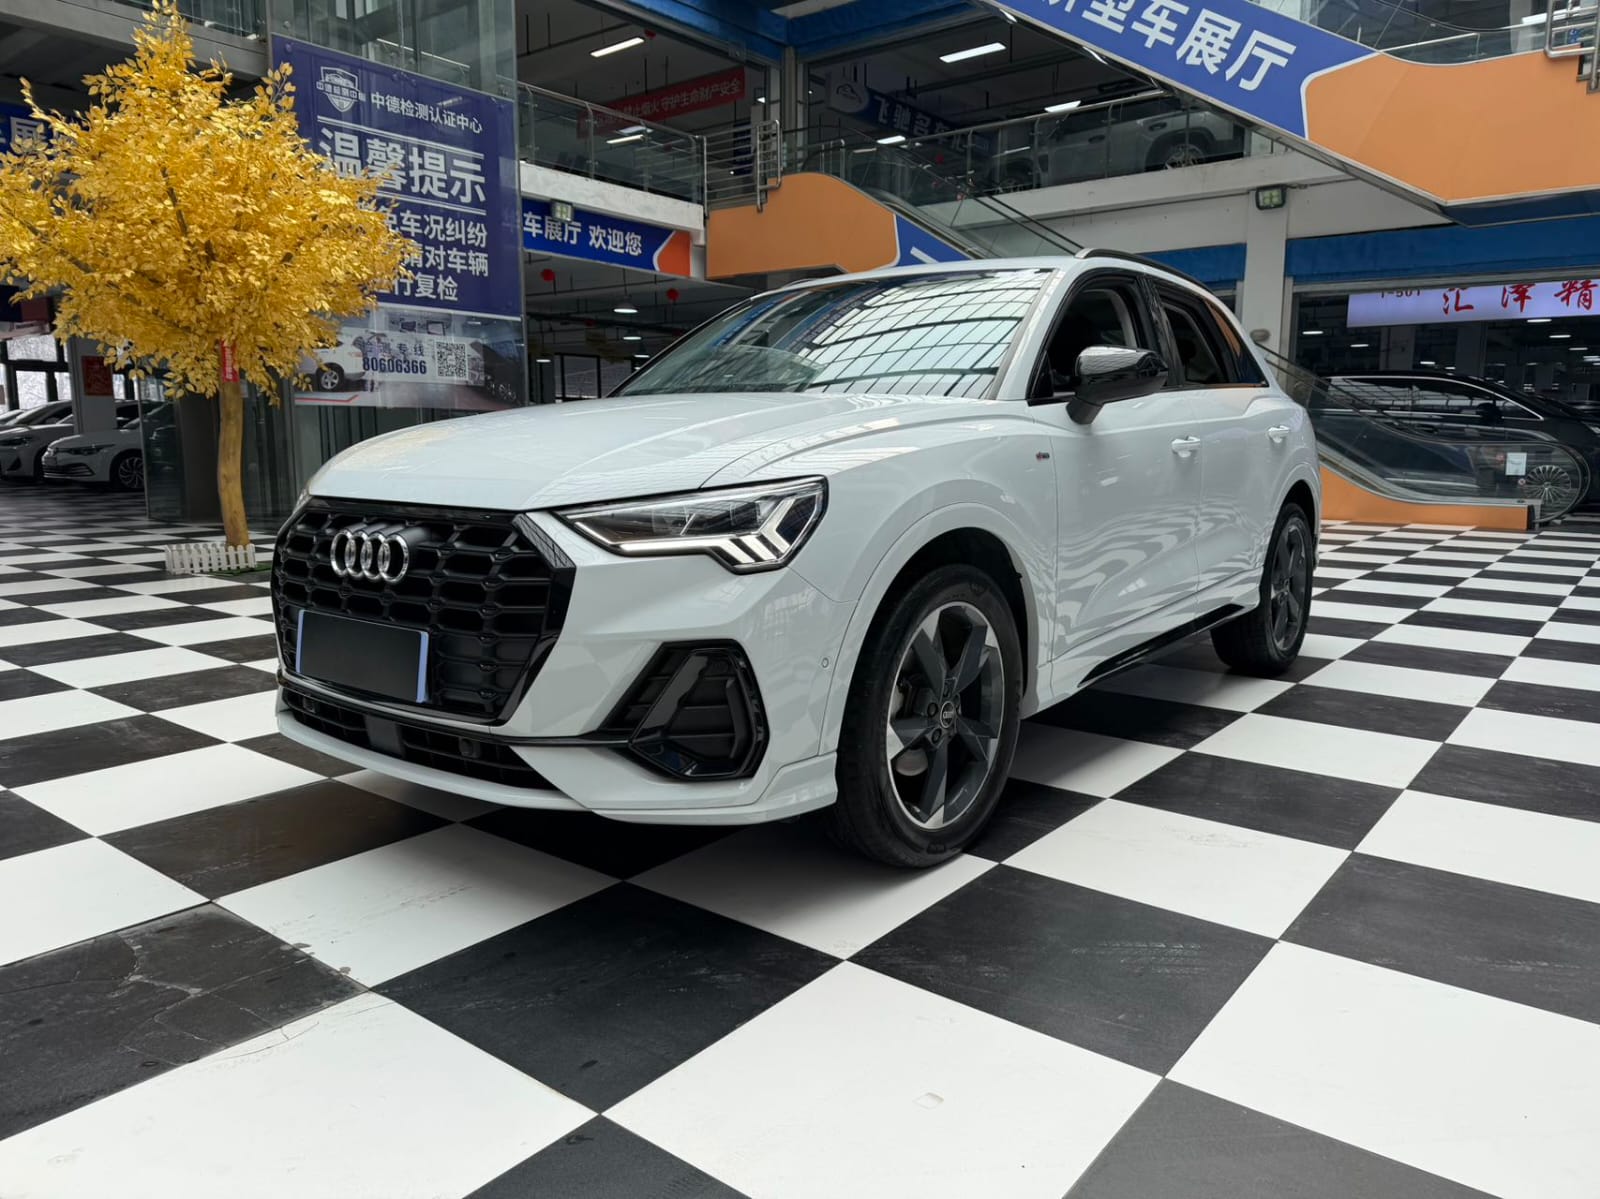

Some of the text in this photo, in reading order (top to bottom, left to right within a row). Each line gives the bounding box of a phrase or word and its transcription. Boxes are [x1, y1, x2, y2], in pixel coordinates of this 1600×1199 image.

[1043, 0, 1296, 91] 型车展厅
[371, 92, 482, 134] 中德检测认证中心
[319, 127, 487, 204] 温馨提示
[357, 202, 487, 248] 免车况纠纷
[523, 211, 642, 256] 车展厅 欢迎您
[375, 271, 459, 301] 行复检
[363, 357, 427, 375] 80606366
